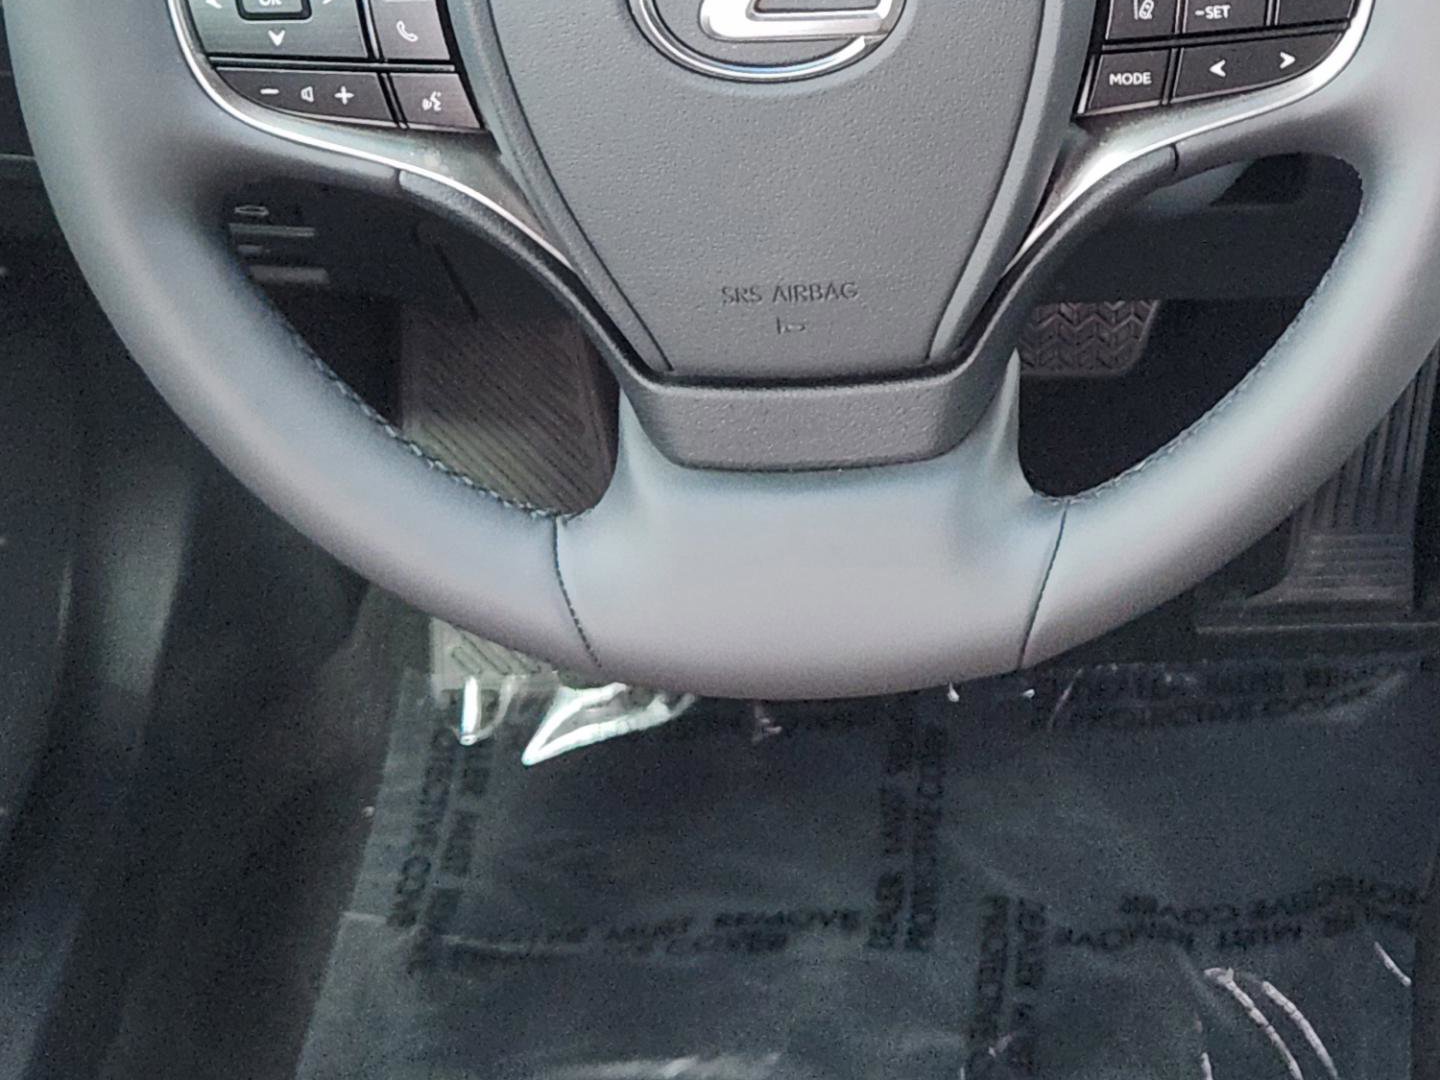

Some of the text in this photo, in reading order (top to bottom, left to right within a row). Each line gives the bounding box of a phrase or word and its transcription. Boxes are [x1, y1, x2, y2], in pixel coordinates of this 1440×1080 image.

[1108, 72, 1153, 86] MODE
[721, 281, 860, 304] SRS AIRBAG
